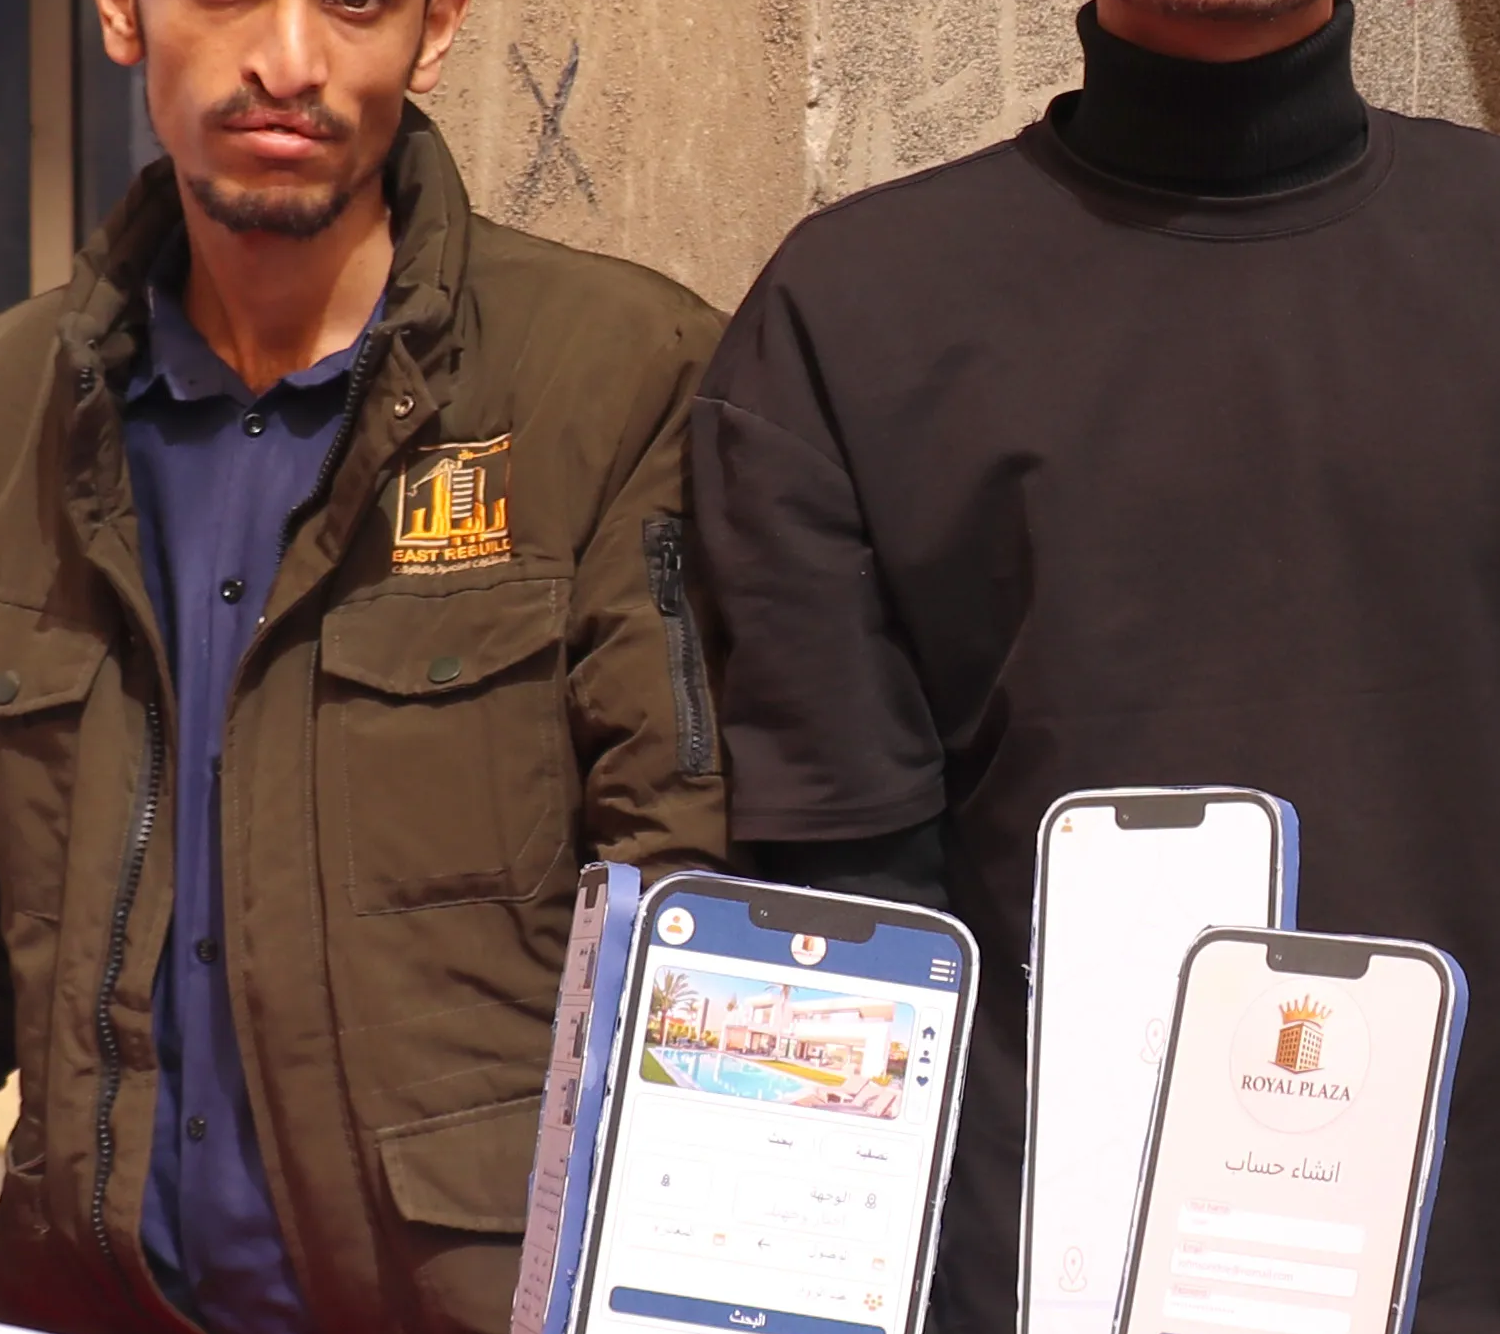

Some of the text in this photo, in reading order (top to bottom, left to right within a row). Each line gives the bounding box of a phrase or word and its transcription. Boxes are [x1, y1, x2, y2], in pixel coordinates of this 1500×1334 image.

[392, 549, 440, 563] EAST
[1241, 1074, 1351, 1101] ROYAL PLAZA
[1225, 1151, 1341, 1183] انشاء حساب
[728, 1309, 767, 1328] البحث
